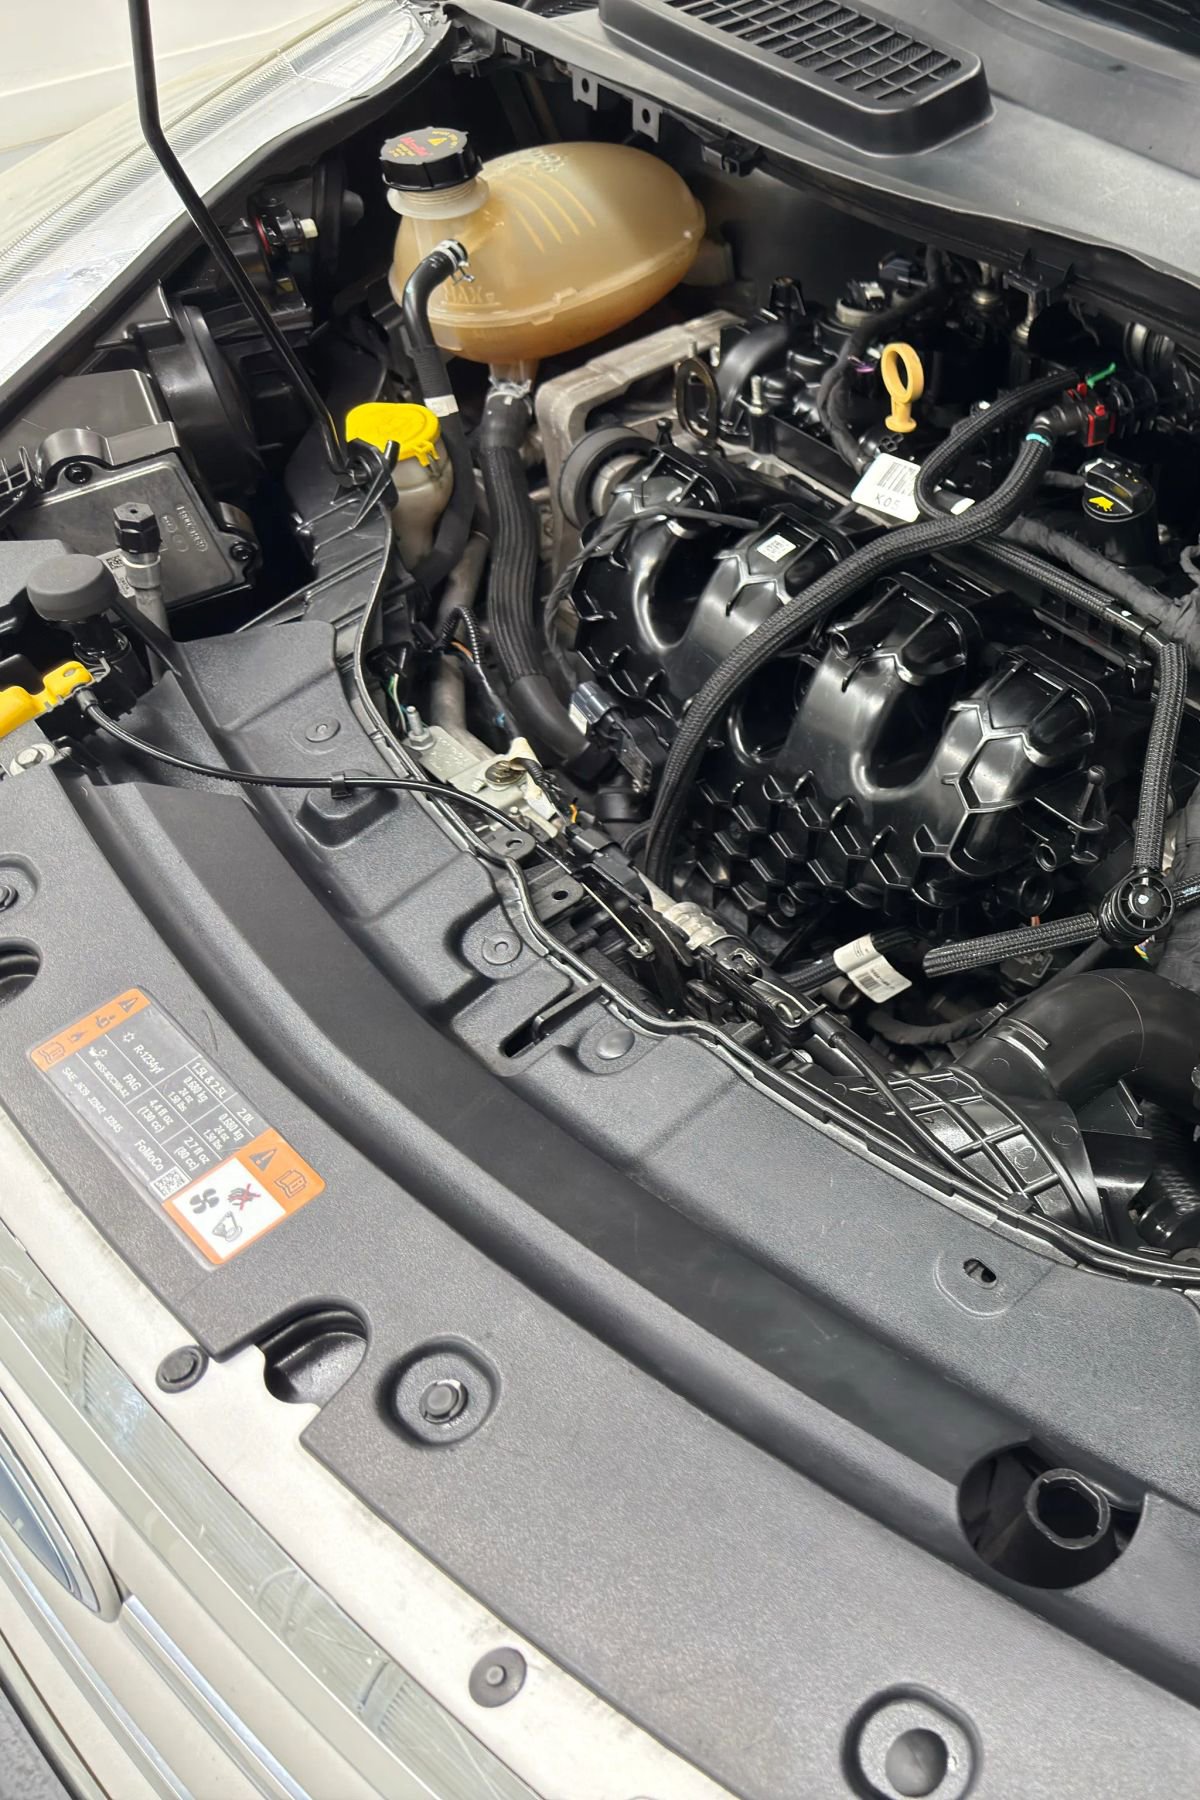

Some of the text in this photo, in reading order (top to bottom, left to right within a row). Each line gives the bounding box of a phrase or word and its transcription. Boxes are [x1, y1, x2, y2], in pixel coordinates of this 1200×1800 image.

[130, 1043, 165, 1076] R-1234yf
[60, 1065, 78, 1082] SAE
[121, 1073, 142, 1091] PAG
[190, 1061, 210, 1079] 1.5L
[209, 1081, 229, 1099] 2.5L
[177, 1087, 189, 1098] 24
[194, 1090, 211, 1104] kg
[135, 1105, 166, 1134] (130 cc)
[147, 1097, 163, 1111] 4.4
[162, 1113, 175, 1125] oz
[235, 1106, 256, 1126] 2.0L
[213, 1124, 225, 1135] 24
[229, 1127, 246, 1142] kg
[132, 1138, 166, 1172] FoMoCo
[182, 1135, 199, 1150] 2.7
[197, 1151, 212, 1164] oz
[182, 1155, 200, 1172] cc)
